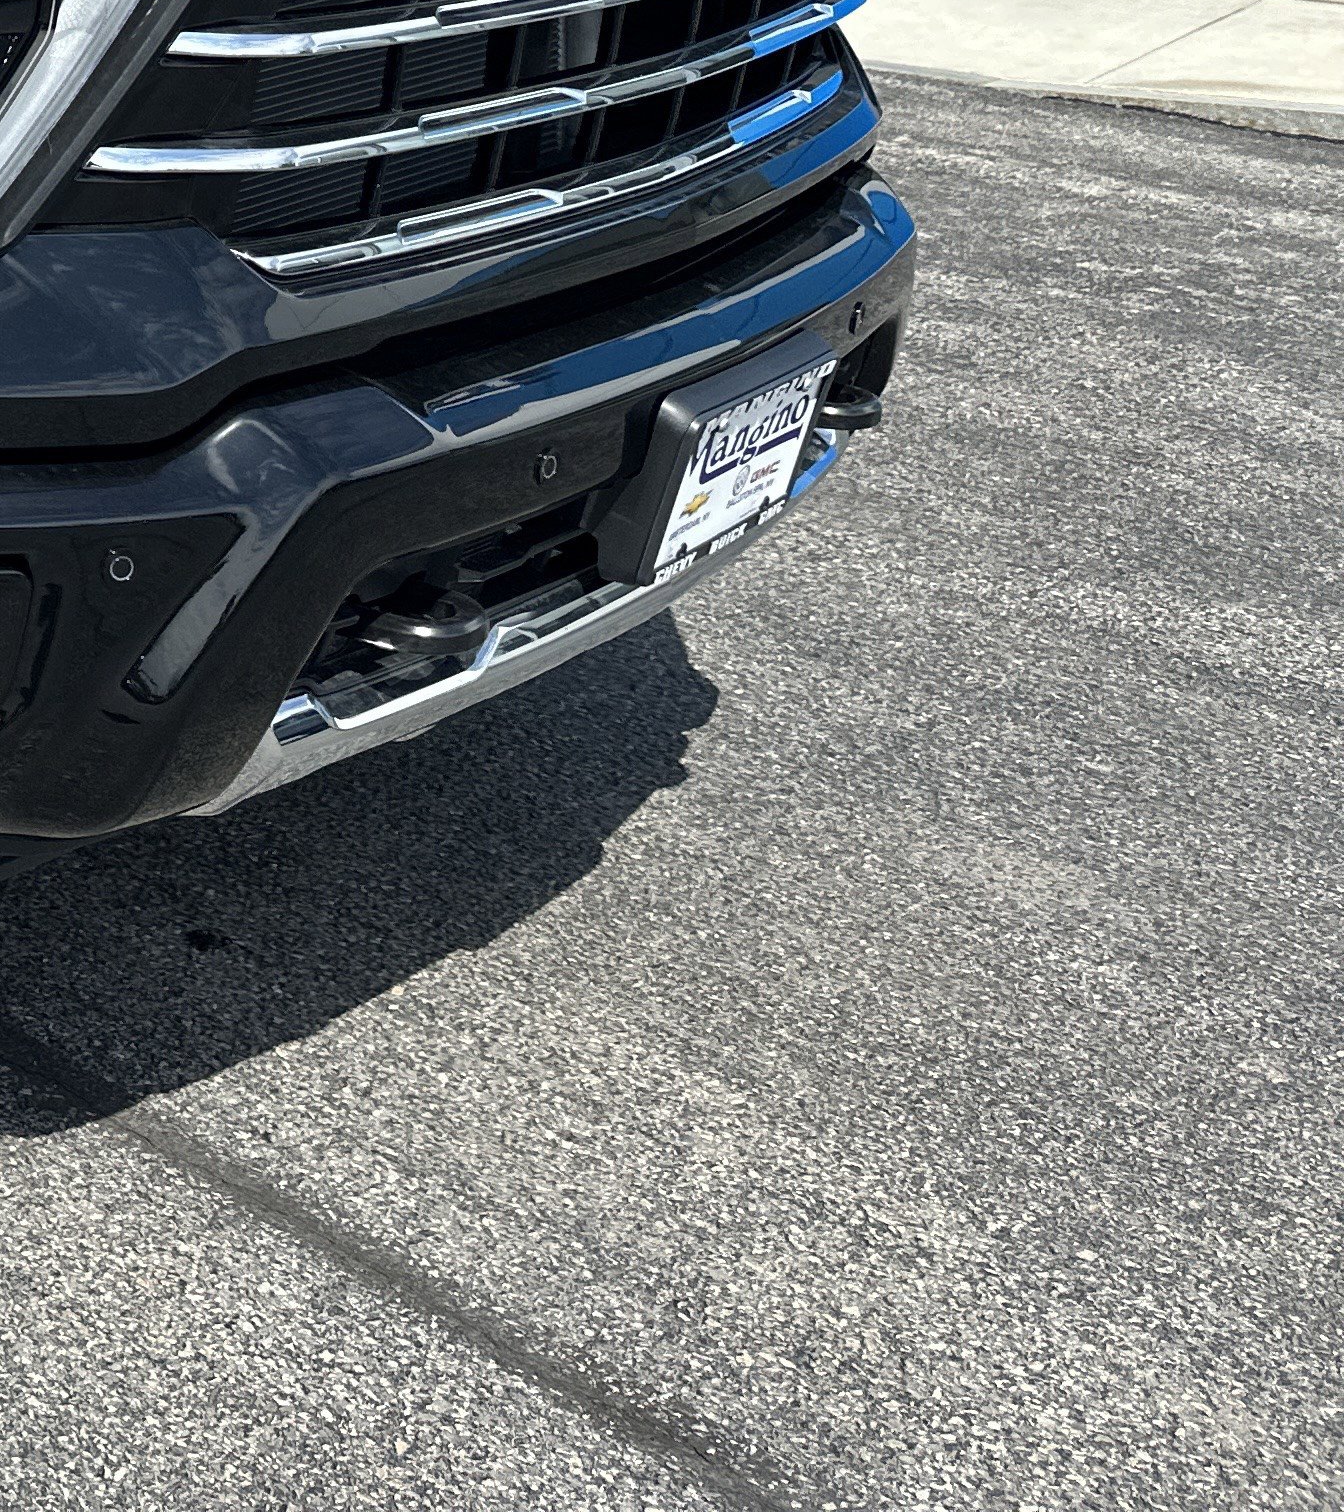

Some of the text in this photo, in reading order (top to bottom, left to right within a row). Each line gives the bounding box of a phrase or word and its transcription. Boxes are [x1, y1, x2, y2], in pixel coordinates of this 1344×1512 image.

[649, 393, 810, 486] Mangino
[653, 551, 698, 586] CHEVY
[708, 522, 748, 555] BUICK
